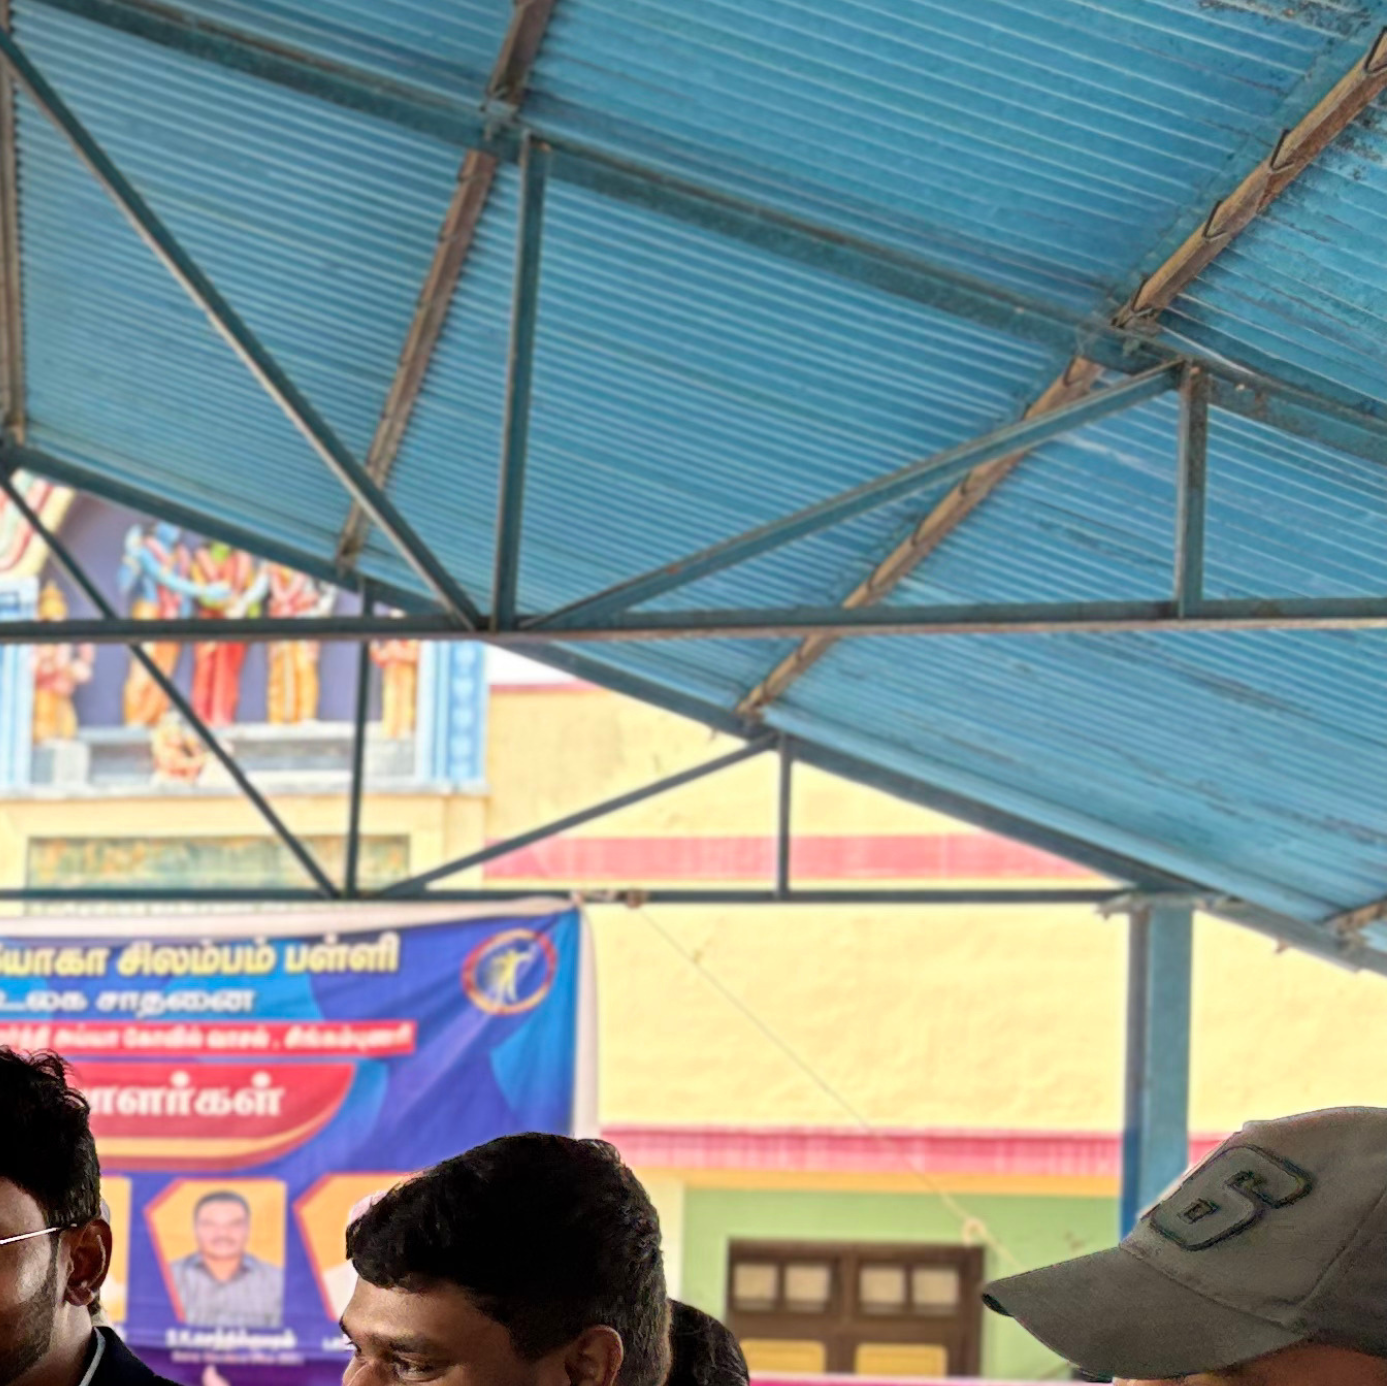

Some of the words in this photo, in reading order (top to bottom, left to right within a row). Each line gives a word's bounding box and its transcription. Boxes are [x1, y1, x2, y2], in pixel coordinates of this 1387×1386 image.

[116, 935, 277, 976] சிலம்பம்
[283, 932, 401, 973] பள்ளி
[95, 989, 257, 1018] சாதனை
